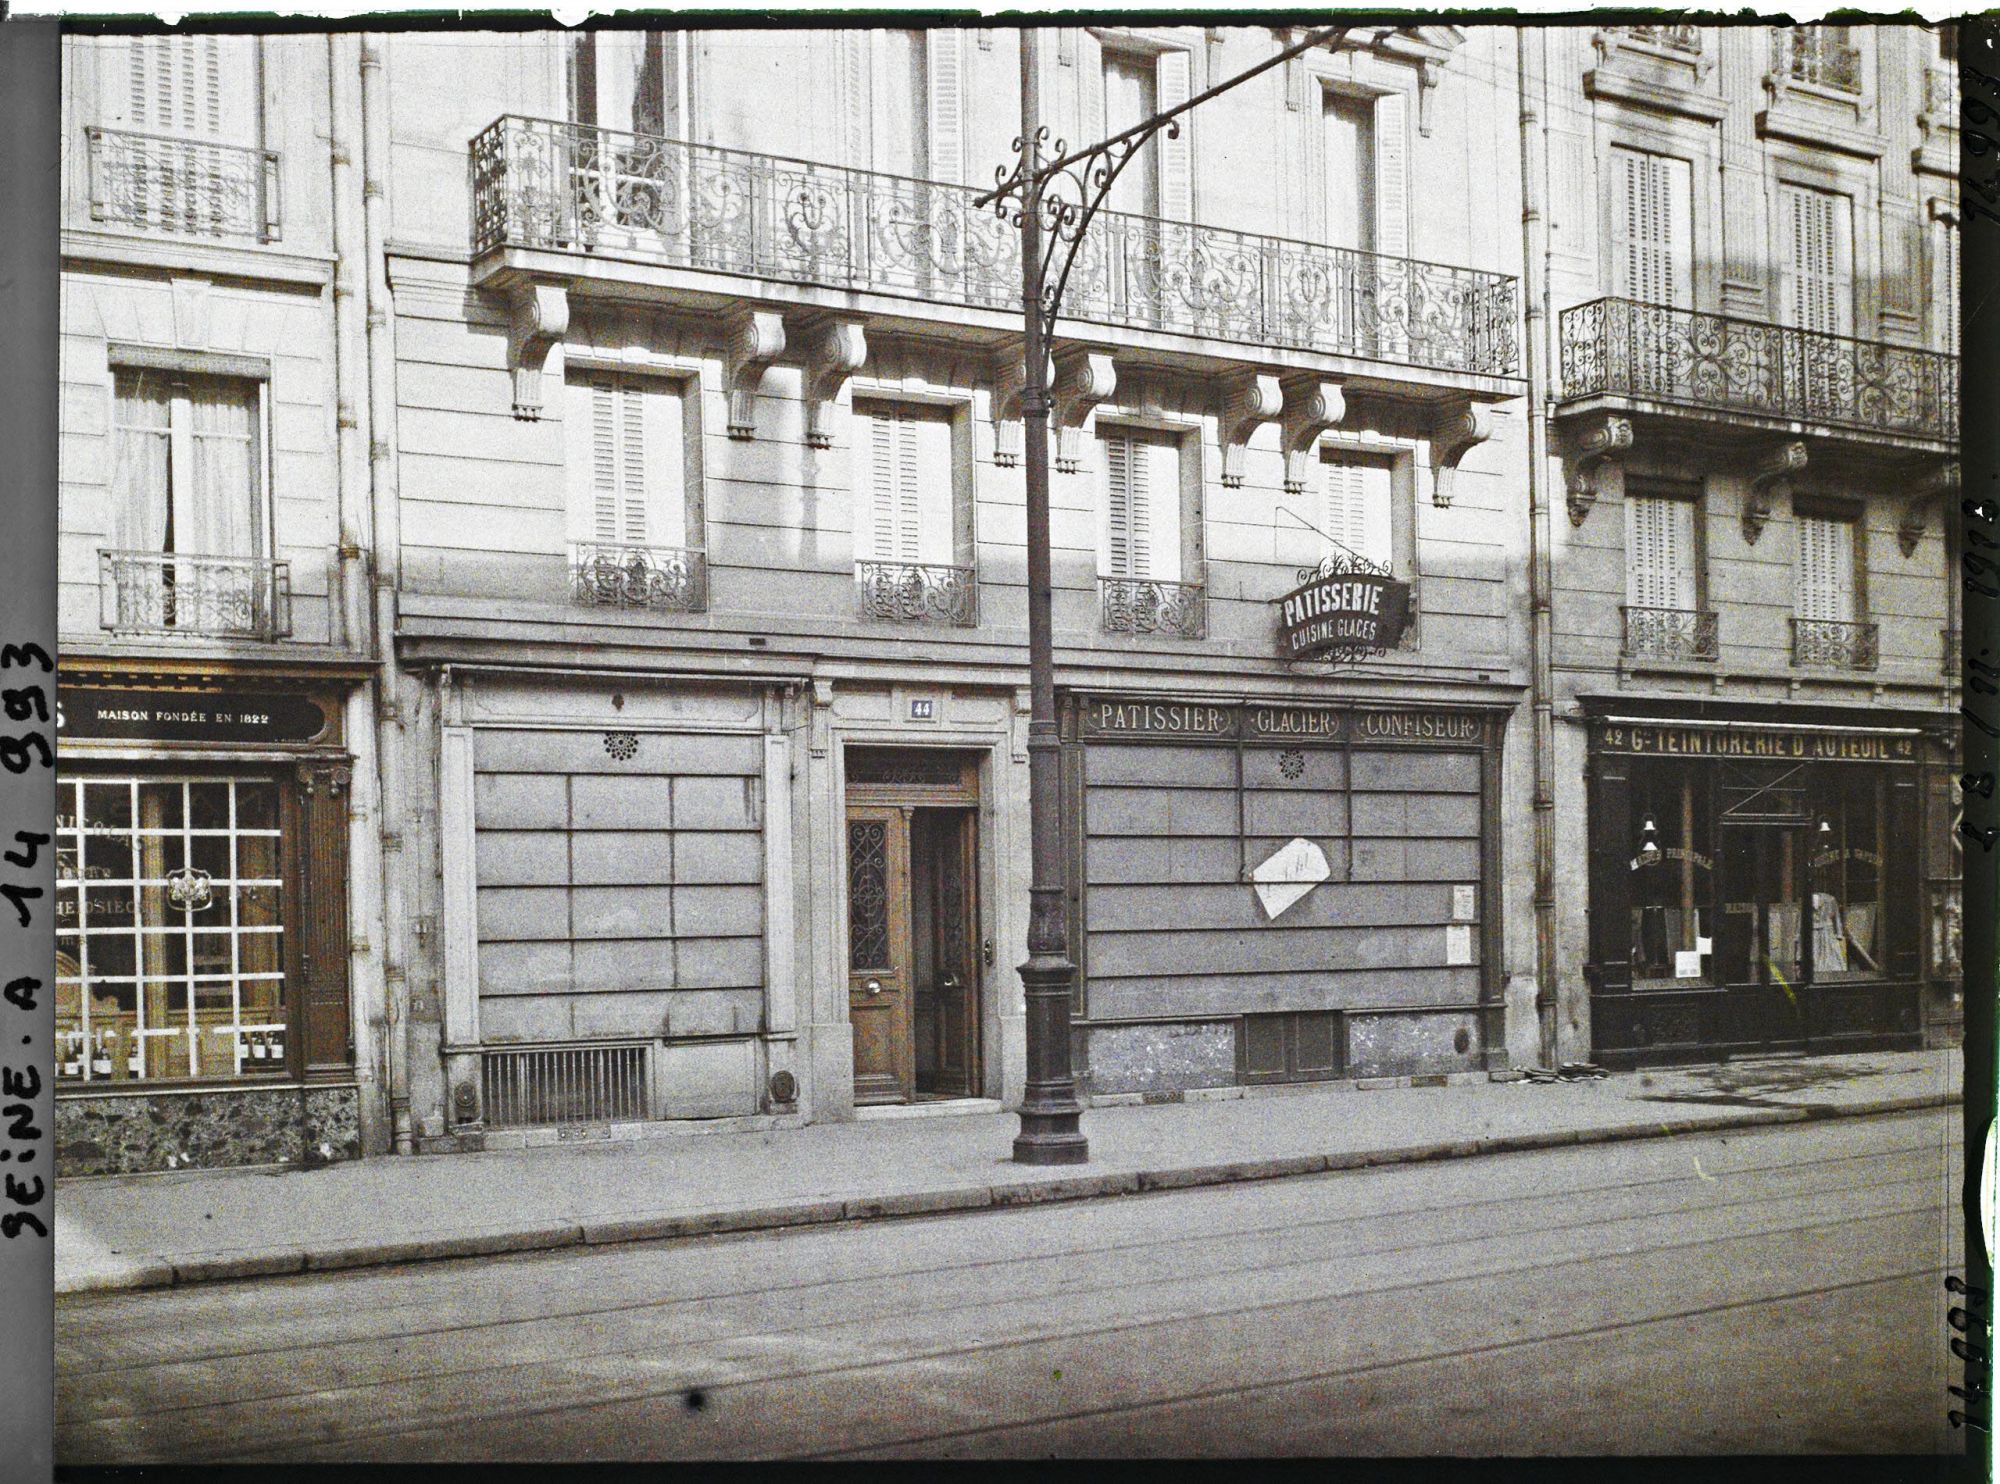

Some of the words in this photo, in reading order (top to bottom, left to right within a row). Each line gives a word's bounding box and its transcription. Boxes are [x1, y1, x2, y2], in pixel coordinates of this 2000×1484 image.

[1284, 582, 1384, 627] PATISSERIE
[1292, 619, 1334, 650] CUISINE
[1338, 618, 1377, 641] GLACES
[0, 642, 53, 774] 993
[97, 709, 149, 721] MAISON
[156, 709, 206, 723] FONDÉE
[216, 713, 232, 723] EN
[240, 713, 269, 724] 1822
[914, 702, 930, 716] 44
[1101, 704, 1219, 732] PATISSIER
[1257, 709, 1330, 734] GLACIER
[1367, 712, 1471, 738] CONFISEUR
[1604, 728, 1623, 746] 42
[1656, 730, 1785, 756] TEINTURERIE
[0, 830, 50, 928] 14
[4, 976, 42, 1011] A
